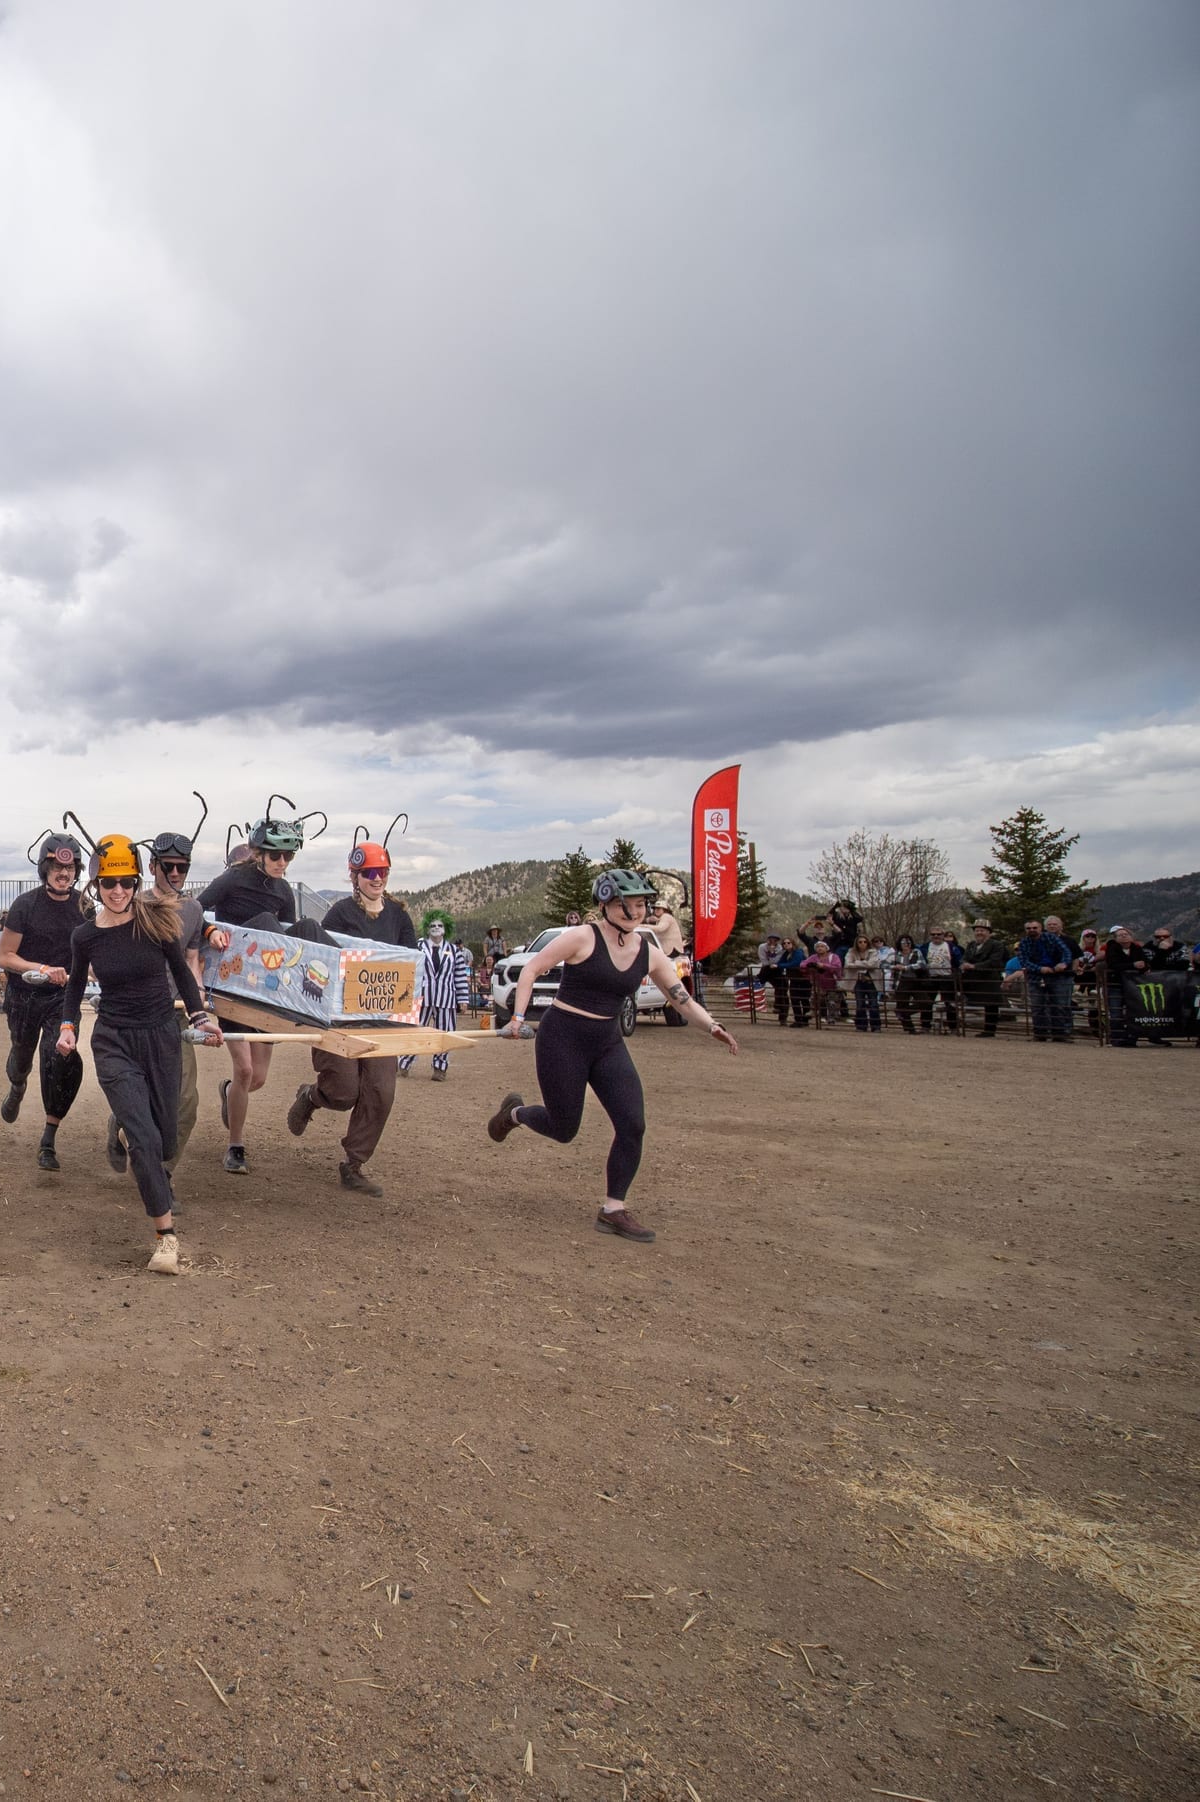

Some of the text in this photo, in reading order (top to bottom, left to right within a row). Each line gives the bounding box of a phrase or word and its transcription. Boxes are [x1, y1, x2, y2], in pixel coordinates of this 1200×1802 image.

[705, 832, 733, 919] Pedersen
[358, 969, 399, 984] Queen
[358, 994, 395, 1011] Lunch
